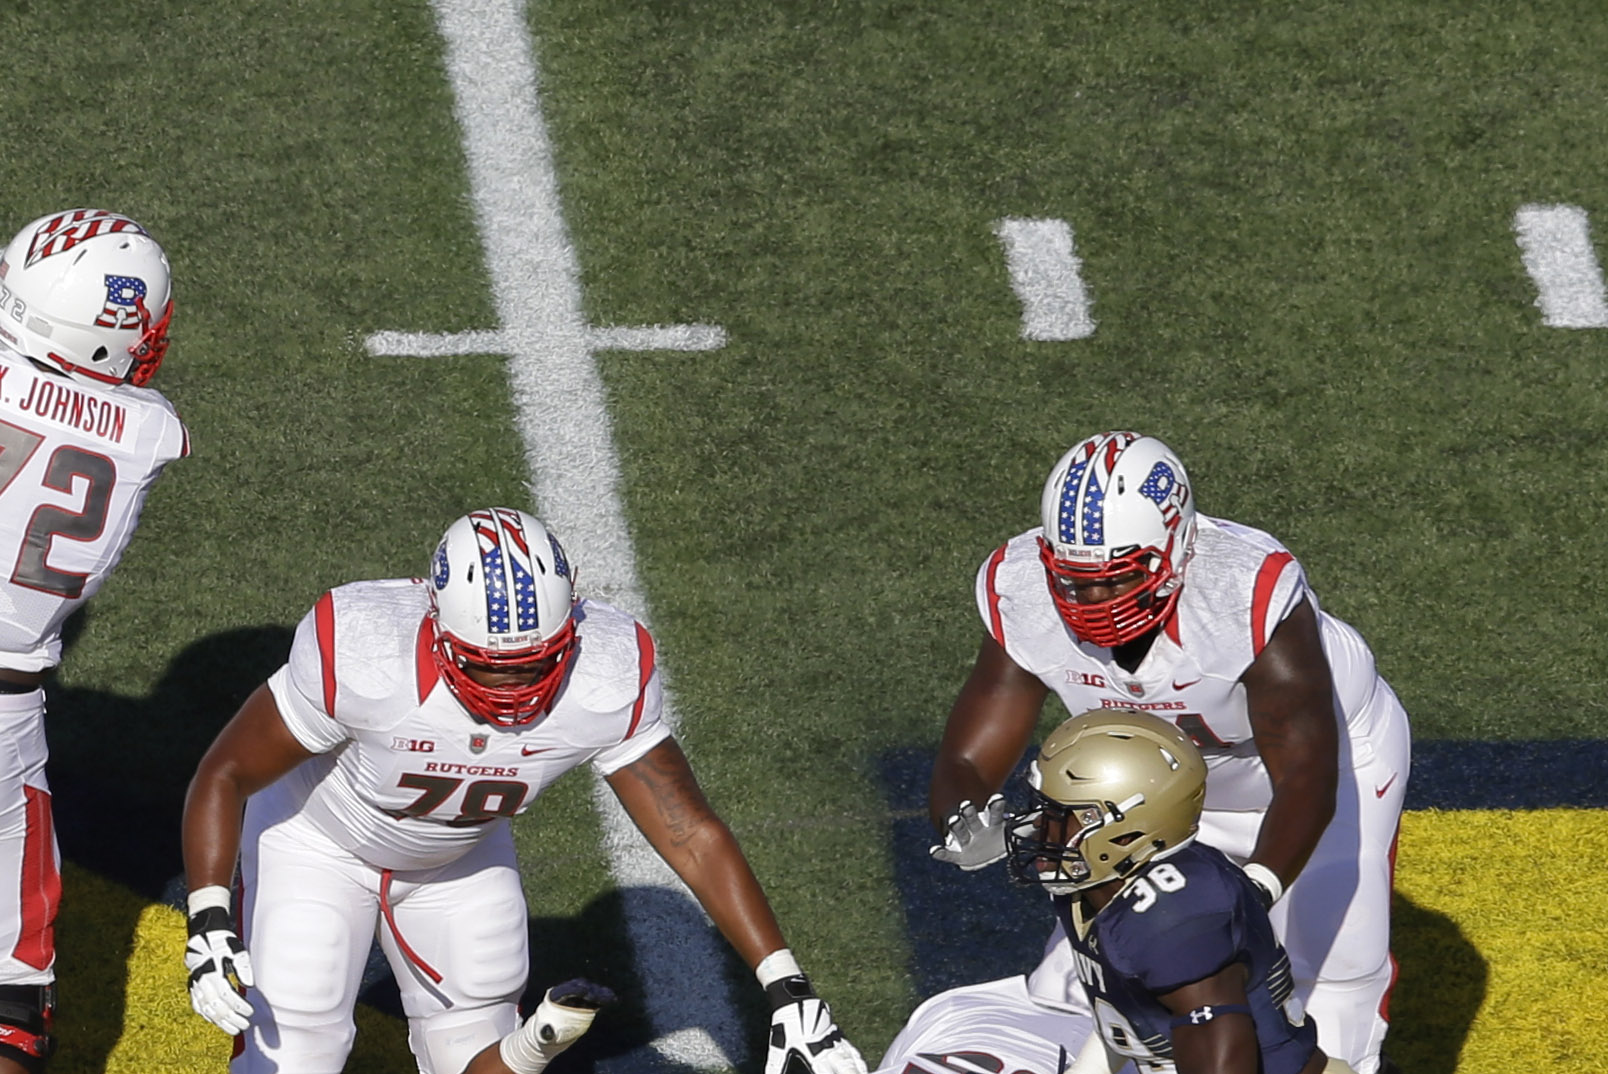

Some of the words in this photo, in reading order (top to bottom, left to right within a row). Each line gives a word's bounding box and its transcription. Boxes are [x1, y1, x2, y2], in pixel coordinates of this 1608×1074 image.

[19, 377, 126, 443] JOHNSON
[424, 762, 520, 777] RUTGERS
[1122, 863, 1187, 913] 38
